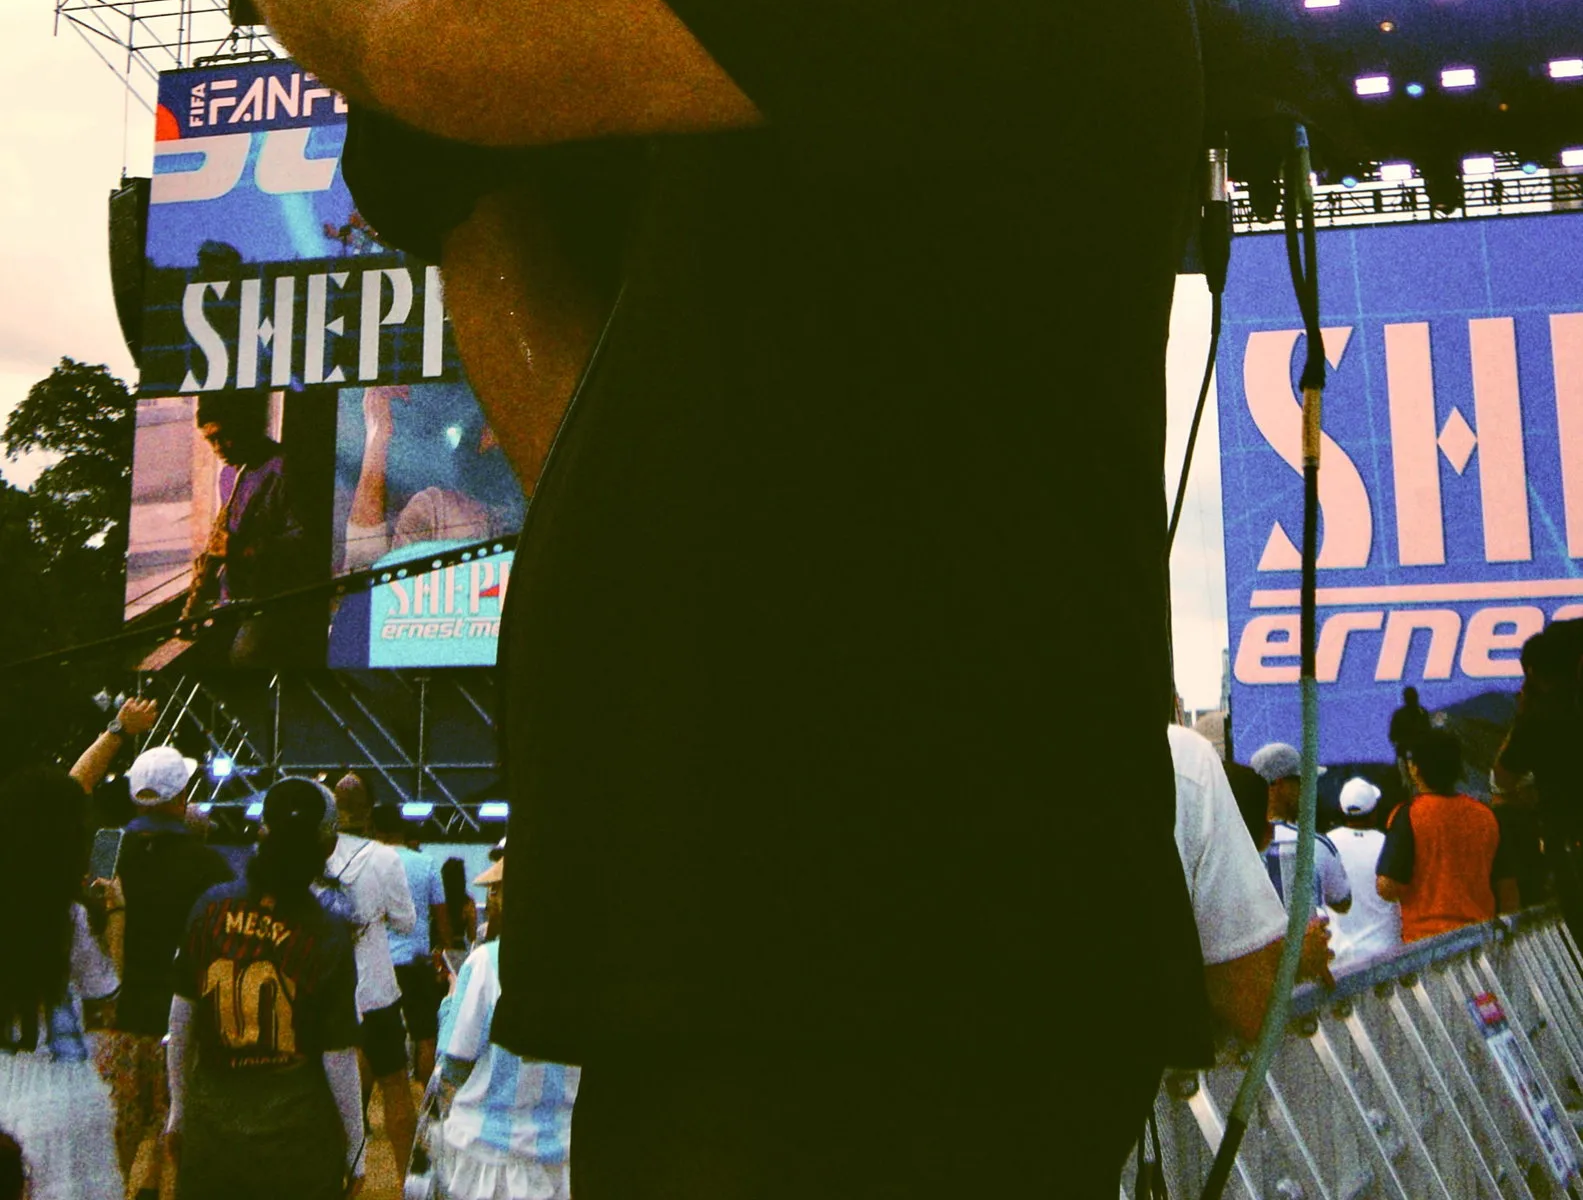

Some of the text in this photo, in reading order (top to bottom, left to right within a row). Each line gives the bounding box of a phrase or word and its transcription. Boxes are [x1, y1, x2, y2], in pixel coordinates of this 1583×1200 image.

[189, 82, 207, 127] FIFA
[381, 618, 465, 639] ernest
[1233, 604, 1583, 685] erne
[224, 911, 291, 946] MESSI
[202, 957, 295, 1053] 10
